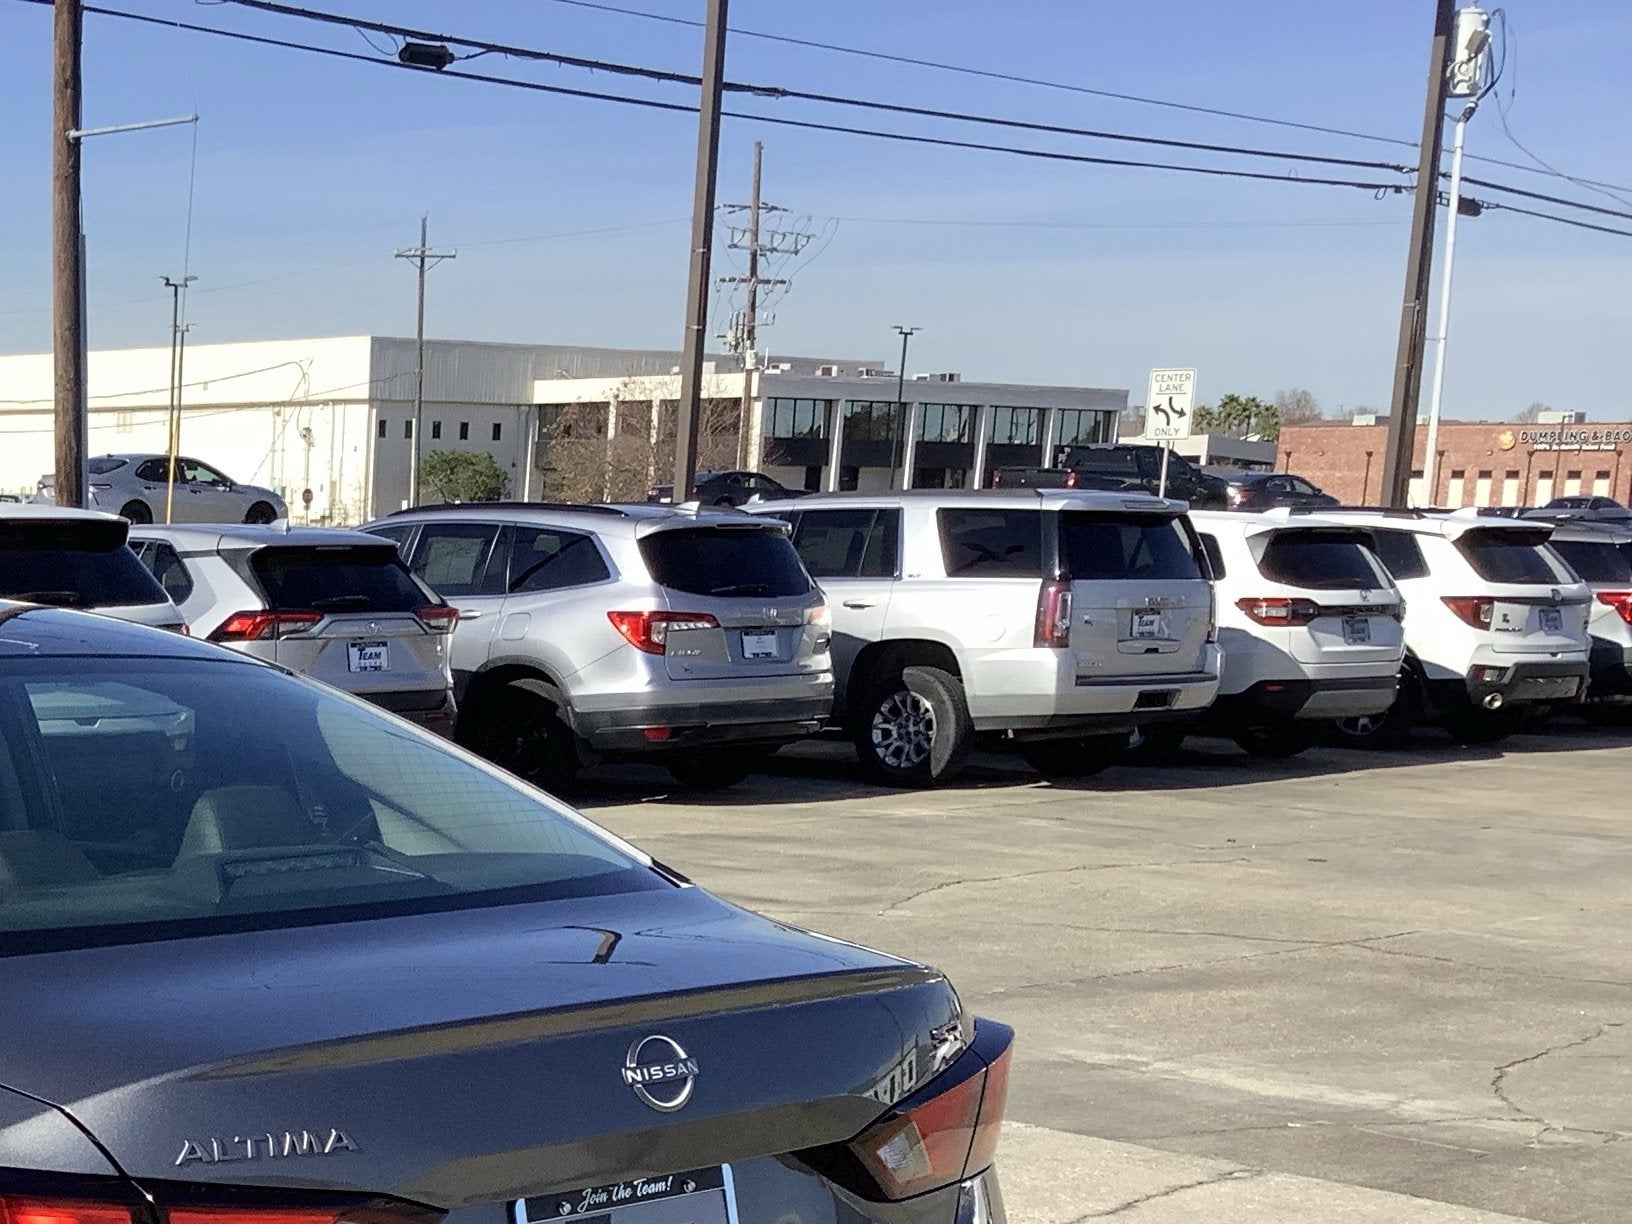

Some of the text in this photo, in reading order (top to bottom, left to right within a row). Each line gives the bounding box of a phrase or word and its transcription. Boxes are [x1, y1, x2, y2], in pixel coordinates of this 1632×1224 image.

[1154, 373, 1192, 383] CENTER
[1159, 383, 1185, 392] LANE
[1154, 427, 1181, 437] ONLY
[1604, 430, 1632, 443] BAO
[626, 1060, 700, 1083] NISSAN
[175, 1128, 360, 1166] ALTIMA
[577, 1187, 609, 1213] Join
[632, 1175, 673, 1198] Team!
